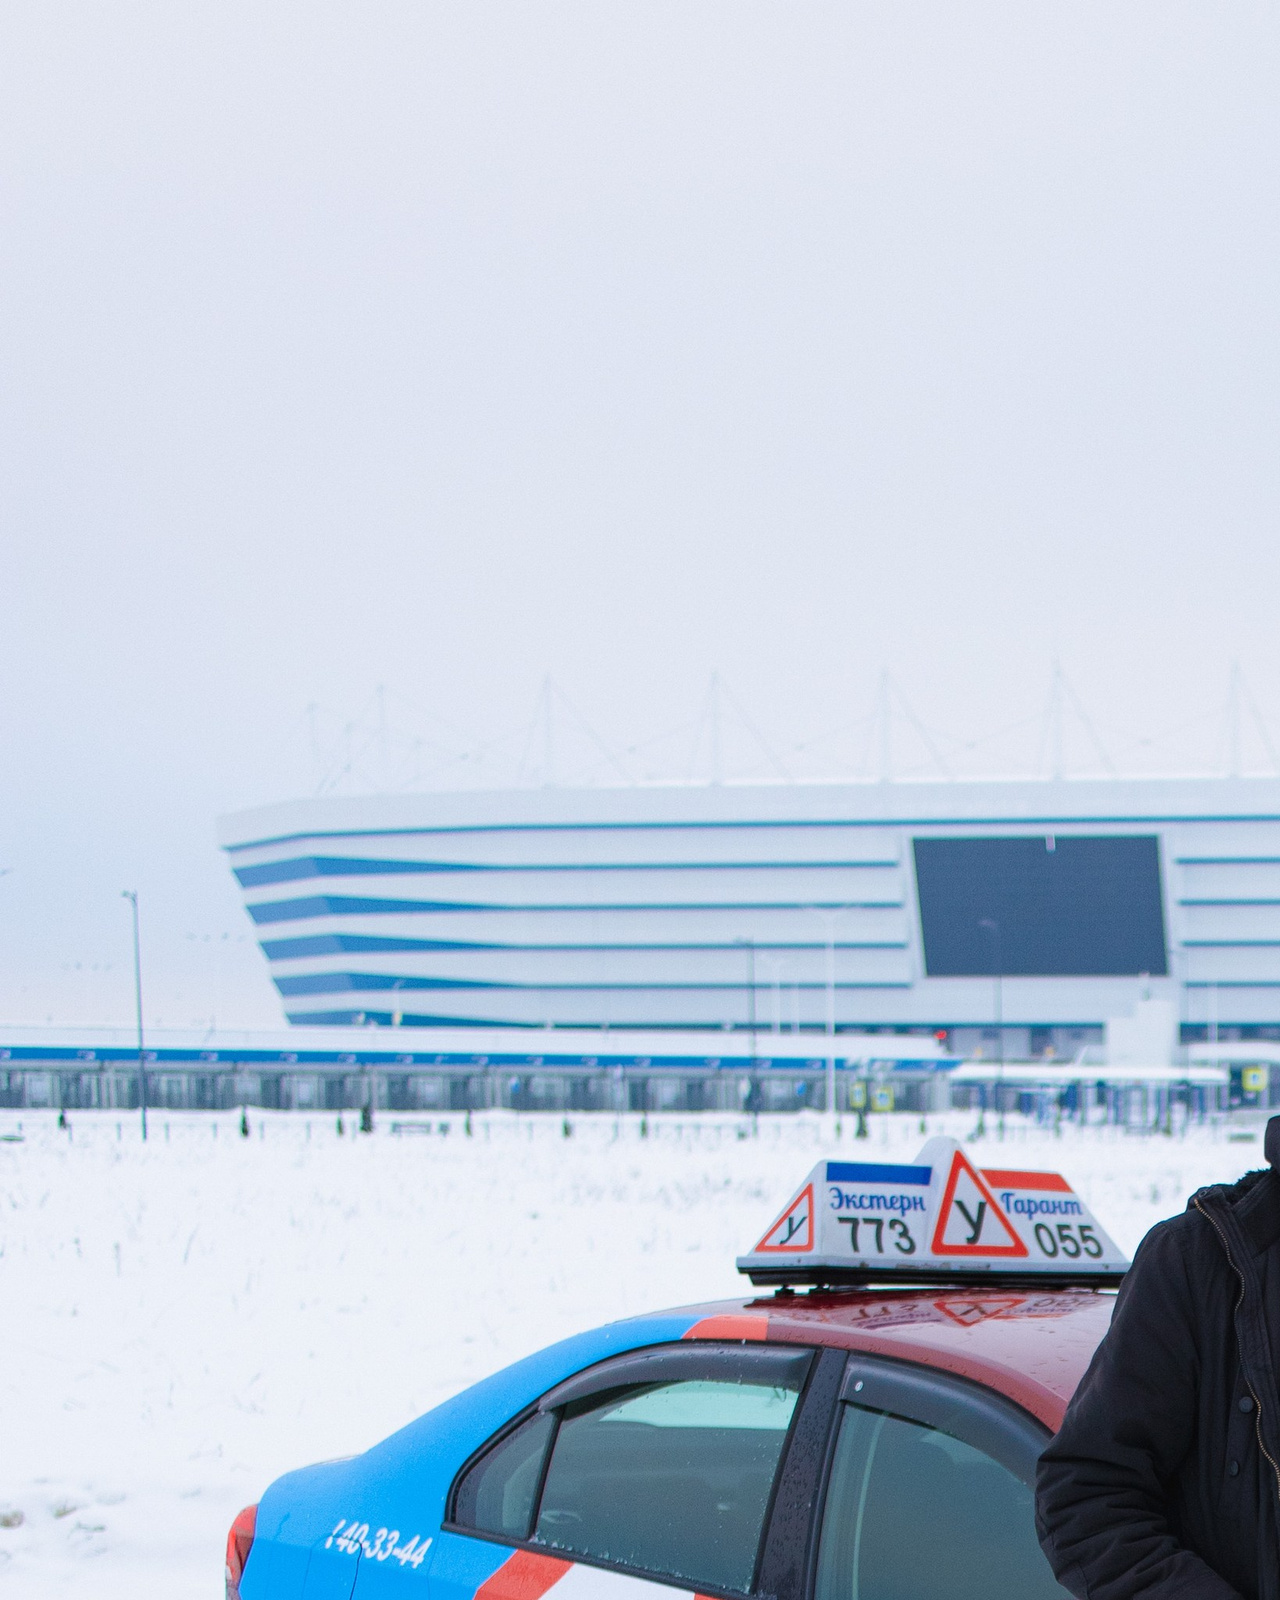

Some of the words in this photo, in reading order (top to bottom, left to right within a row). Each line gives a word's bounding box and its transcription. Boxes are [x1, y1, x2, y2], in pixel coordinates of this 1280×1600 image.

[829, 1187, 926, 1216] Экстерн
[1000, 1192, 1083, 1221] Гарант
[837, 1216, 917, 1255] 773
[1033, 1222, 1104, 1259] 055
